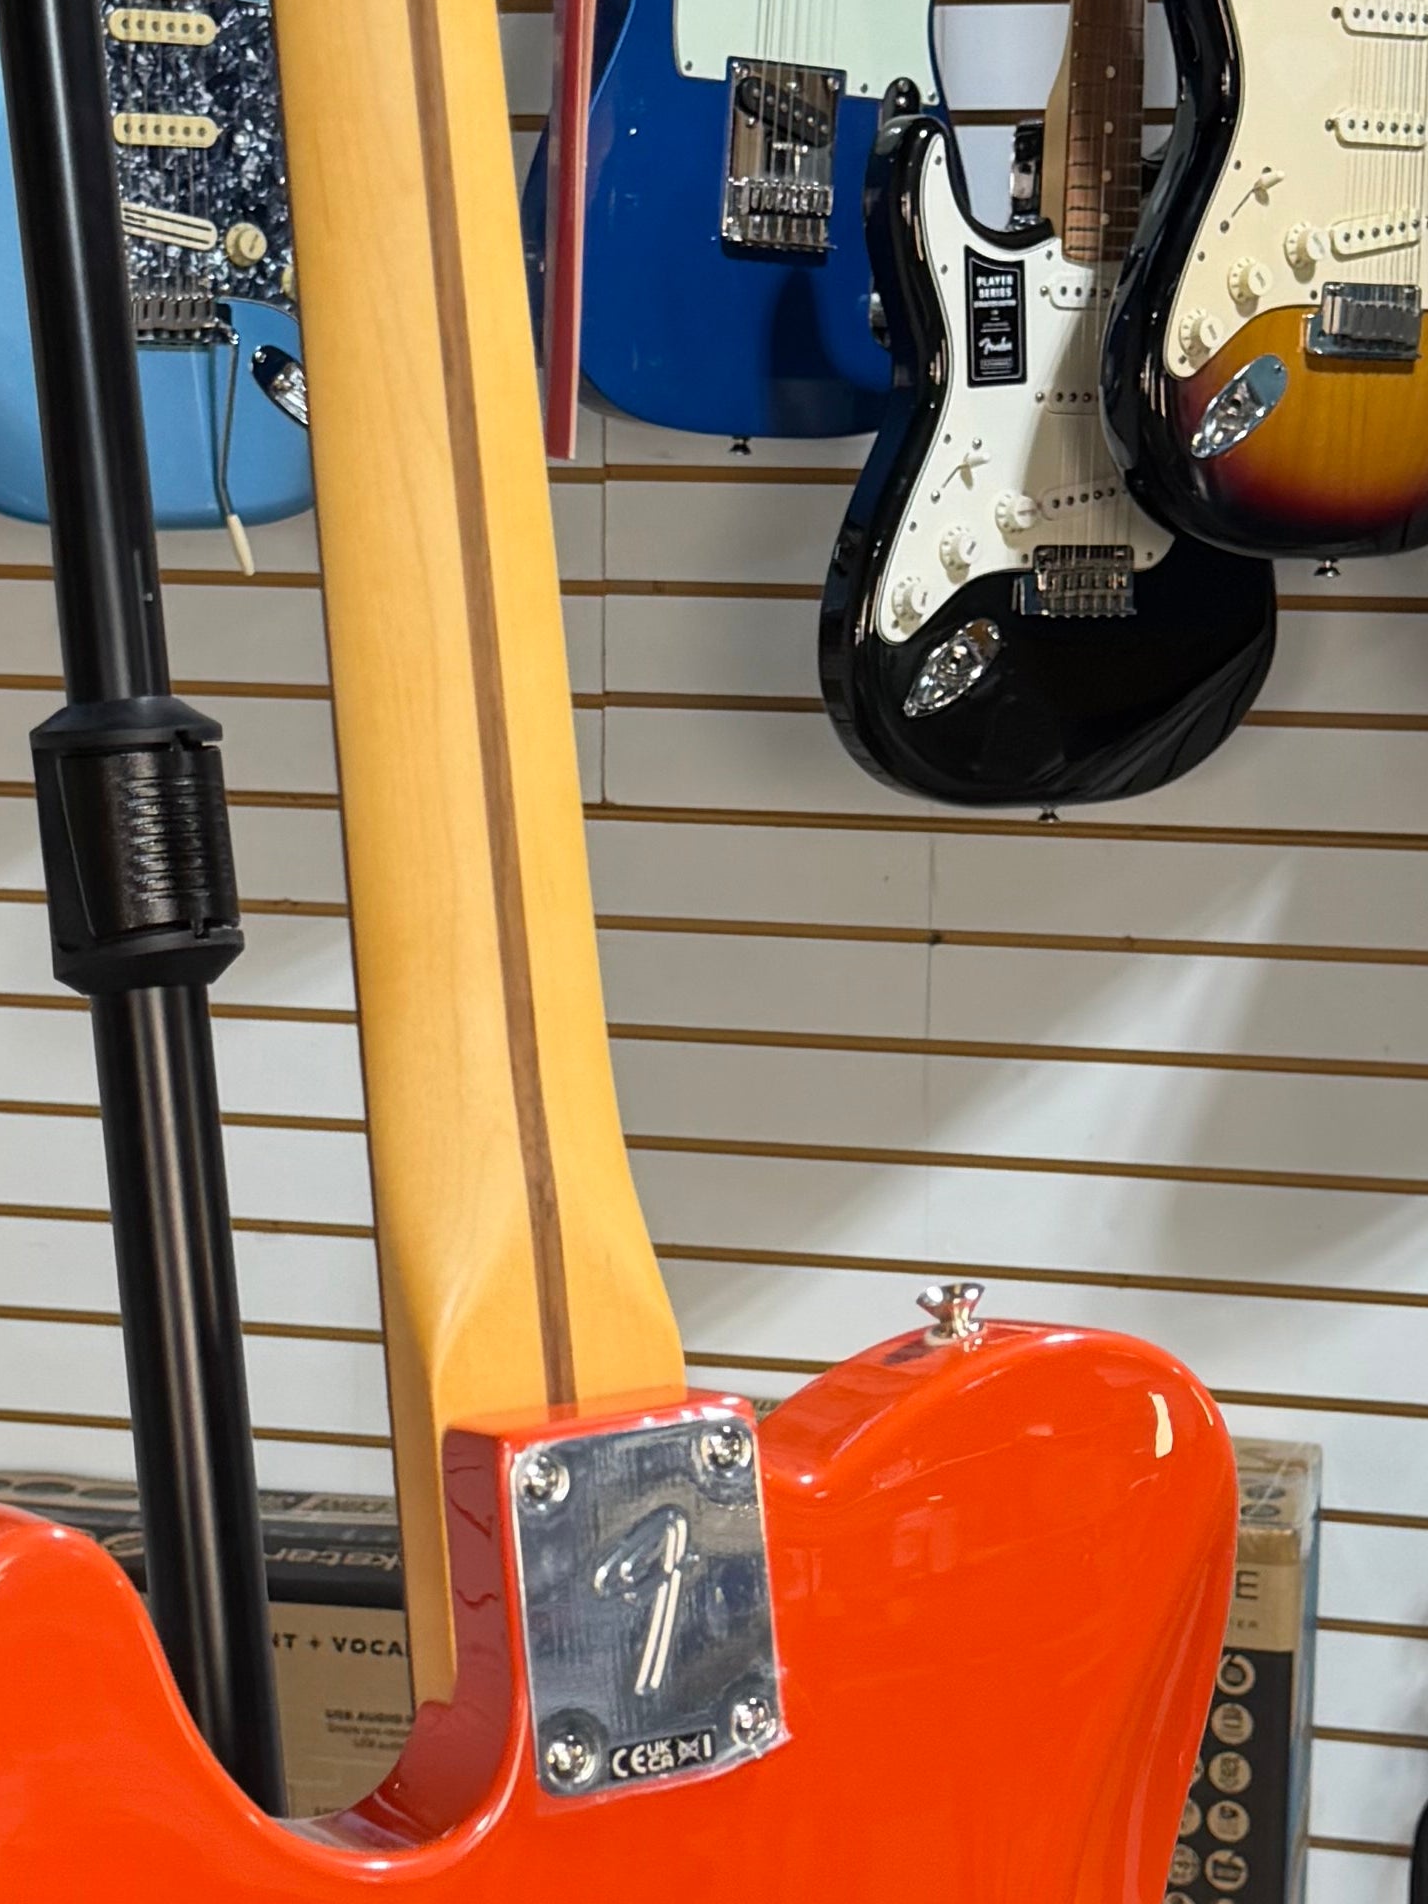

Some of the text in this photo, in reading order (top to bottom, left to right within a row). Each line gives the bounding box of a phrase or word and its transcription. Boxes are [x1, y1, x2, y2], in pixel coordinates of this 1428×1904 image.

[976, 274, 1014, 287] PLAYER
[978, 287, 1013, 299] SERIES
[978, 336, 1013, 356] Fender
[332, 1635, 409, 1658] VOCA
